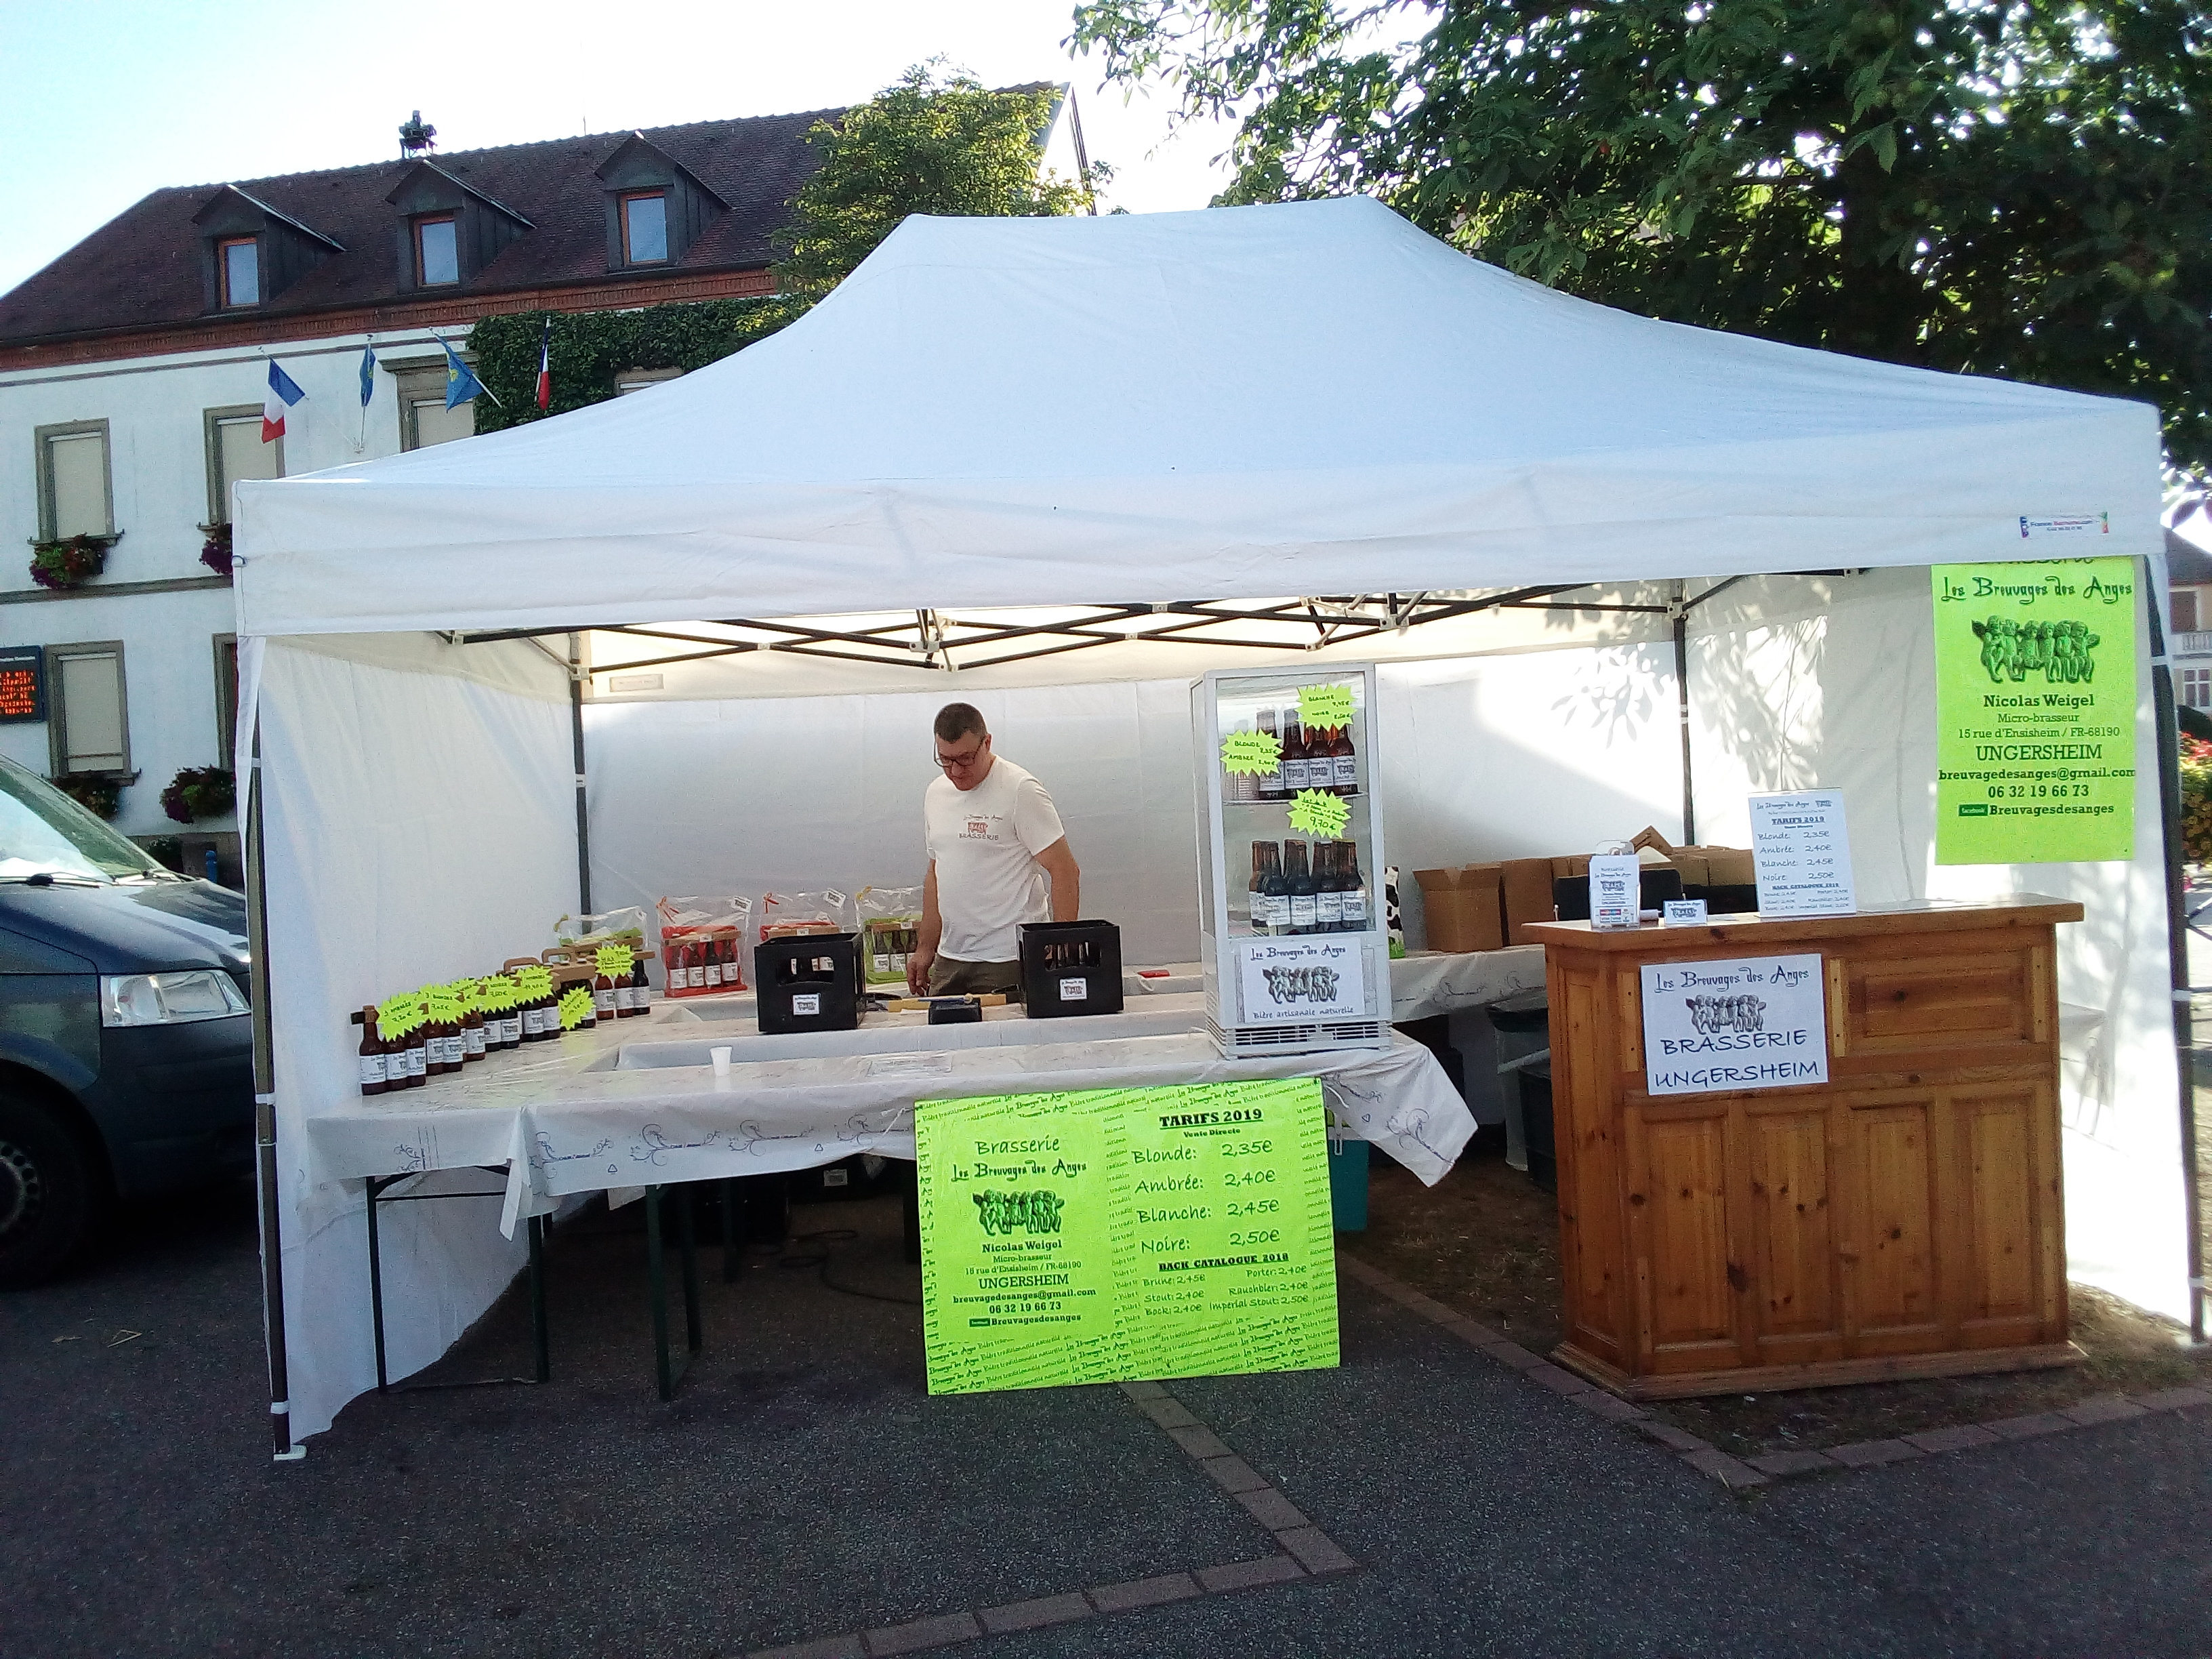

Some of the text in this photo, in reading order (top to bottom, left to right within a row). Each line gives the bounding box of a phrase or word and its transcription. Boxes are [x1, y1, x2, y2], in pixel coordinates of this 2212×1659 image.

[1941, 575, 2133, 605] Les Breuvages des Anges
[1984, 694, 2095, 709] Nicolas Weigel
[1998, 713, 2080, 723] Micro-brasseur
[1959, 729, 1971, 739] 15
[1973, 731, 1992, 739] rue
[1994, 728, 2060, 739] d'Ensisheim
[2070, 726, 2120, 737] FR-68190
[1975, 744, 2103, 760] UNGERSHEIM
[1938, 767, 2136, 782] breuvagedesanges@gmail.com
[1988, 784, 2089, 798] 06 32 19 66 73
[1989, 804, 2114, 817] Breuvagesdesanges
[1250, 948, 1263, 960] Les
[1322, 944, 1346, 958] Anges
[1654, 965, 1809, 993] Les Breuvages des Anges
[1277, 1008, 1315, 1017] artisanale
[1319, 1006, 1354, 1015] naturelle
[1660, 1029, 1807, 1054] BRASSERIE
[1655, 1061, 1820, 1088] UNGERSHEIM
[1159, 1109, 1262, 1127] TARIFS 2019
[1209, 1128, 1241, 1136] Directe
[975, 1134, 1060, 1155] Brasserie
[1132, 1139, 1273, 1164] Blonde: 2,35€
[951, 1158, 1087, 1182] Les Breuvages des Anges
[1134, 1170, 1276, 1194] Ambrée: 2,40€
[1136, 1199, 1280, 1224] Blanche: 2,45€
[983, 1240, 1062, 1253] Nicolas Weigel
[1141, 1229, 1281, 1254] Noire: 2,50€
[993, 1254, 1052, 1263] Micro-brasseur
[1159, 1261, 1189, 1271] BACK
[1193, 1255, 1258, 1268] CATALOGUE
[991, 1264, 1039, 1274] d'Ensisheim
[978, 1273, 1069, 1289] UNGERSHEIM
[953, 1288, 1097, 1303] breuvagedesanges@gmail.com
[989, 1301, 1061, 1314] 06 32 19 66 73
[991, 1314, 1081, 1326] Breuvagesdesanges
